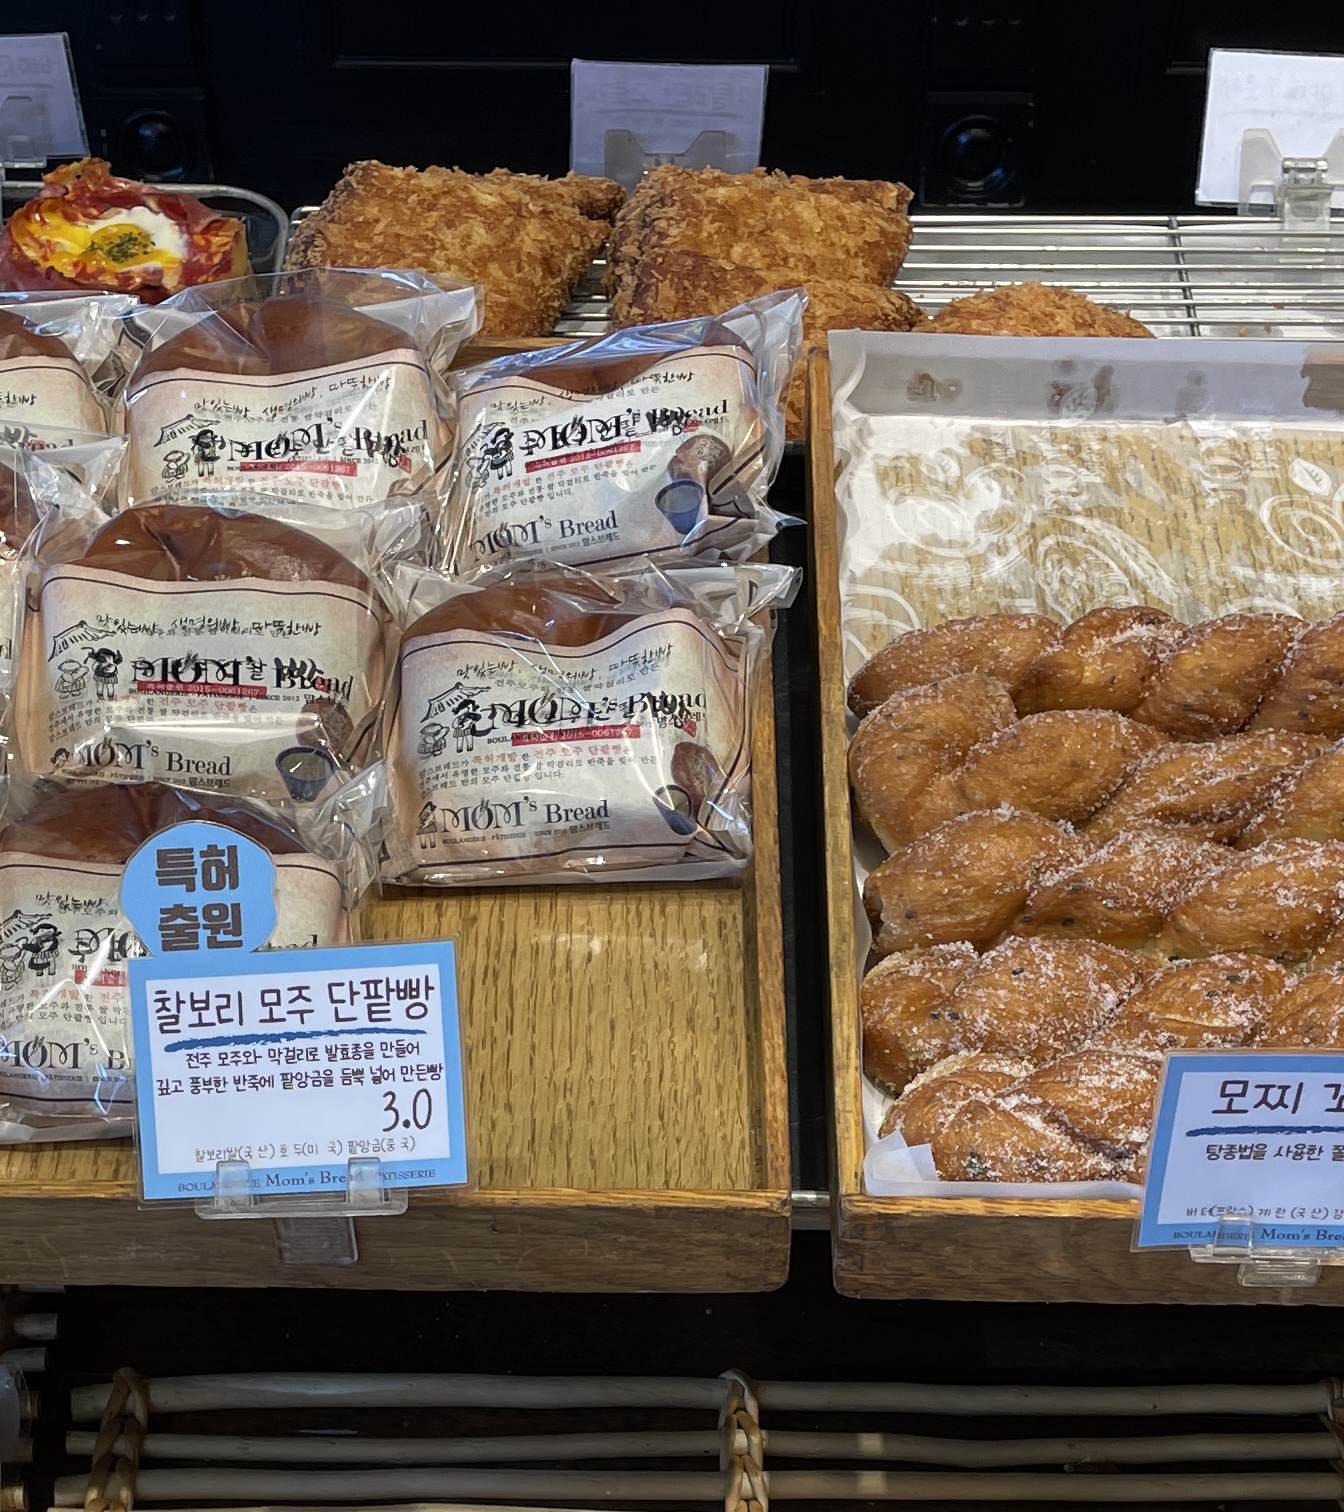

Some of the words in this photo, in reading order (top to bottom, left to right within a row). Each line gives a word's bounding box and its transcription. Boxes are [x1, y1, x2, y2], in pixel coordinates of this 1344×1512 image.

[559, 511, 618, 539] Bread
[166, 750, 232, 776] Bread
[441, 795, 537, 835] MOM's
[545, 799, 610, 824] Bread
[154, 843, 240, 894] 특허
[157, 901, 245, 953] 출원
[154, 989, 244, 1034] 찰보리
[258, 984, 315, 1025] 모주
[327, 975, 435, 1023] 단팥빵
[186, 1053, 212, 1069] 전주
[218, 1049, 260, 1068] 모주와
[268, 1047, 320, 1064] 막걸리로
[326, 1043, 375, 1062] 발효종을
[380, 1039, 420, 1057] 만들어
[157, 1078, 184, 1096] 깊고
[190, 1077, 228, 1095] 풍부한
[233, 1075, 274, 1092] 반죽에
[340, 1068, 365, 1086] 듬뿍
[401, 1063, 443, 1082] 만든빵
[382, 1088, 432, 1132] 3.0
[1211, 1079, 1304, 1115] 모찌
[1206, 1144, 1268, 1161] 탕종법을
[1274, 1144, 1324, 1161] 사용한
[266, 1173, 314, 1187] Mom's
[1260, 1228, 1310, 1241] Mom's
